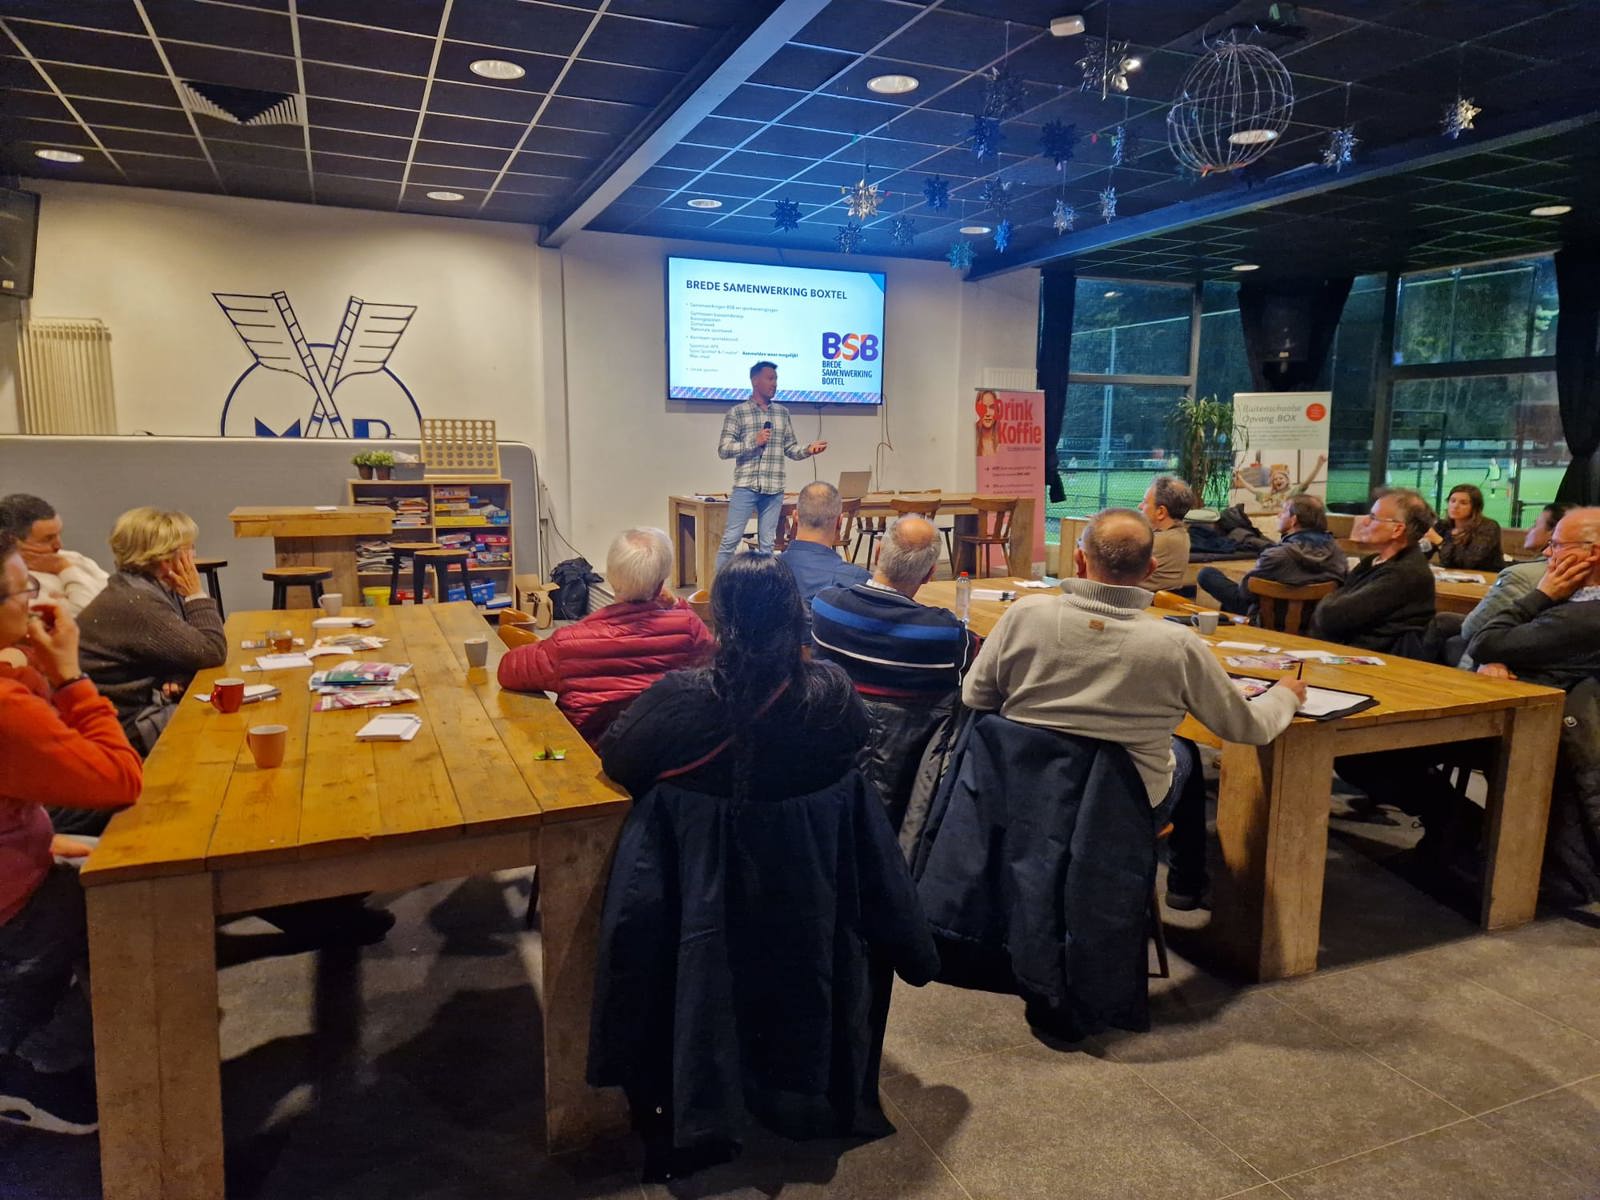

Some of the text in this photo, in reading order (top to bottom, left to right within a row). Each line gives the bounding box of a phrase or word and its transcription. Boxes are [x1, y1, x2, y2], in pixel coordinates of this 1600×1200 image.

[686, 279, 848, 300] BREDE SAMENWERKING BOXTEL
[821, 331, 879, 362] BSB
[821, 360, 842, 369] BREDE
[821, 368, 873, 378] SAMENWERKING
[821, 377, 845, 386] BOXTEL
[994, 398, 1033, 421] Drink
[1242, 414, 1297, 424] Opvang BOX
[998, 422, 1042, 444] Koffie
